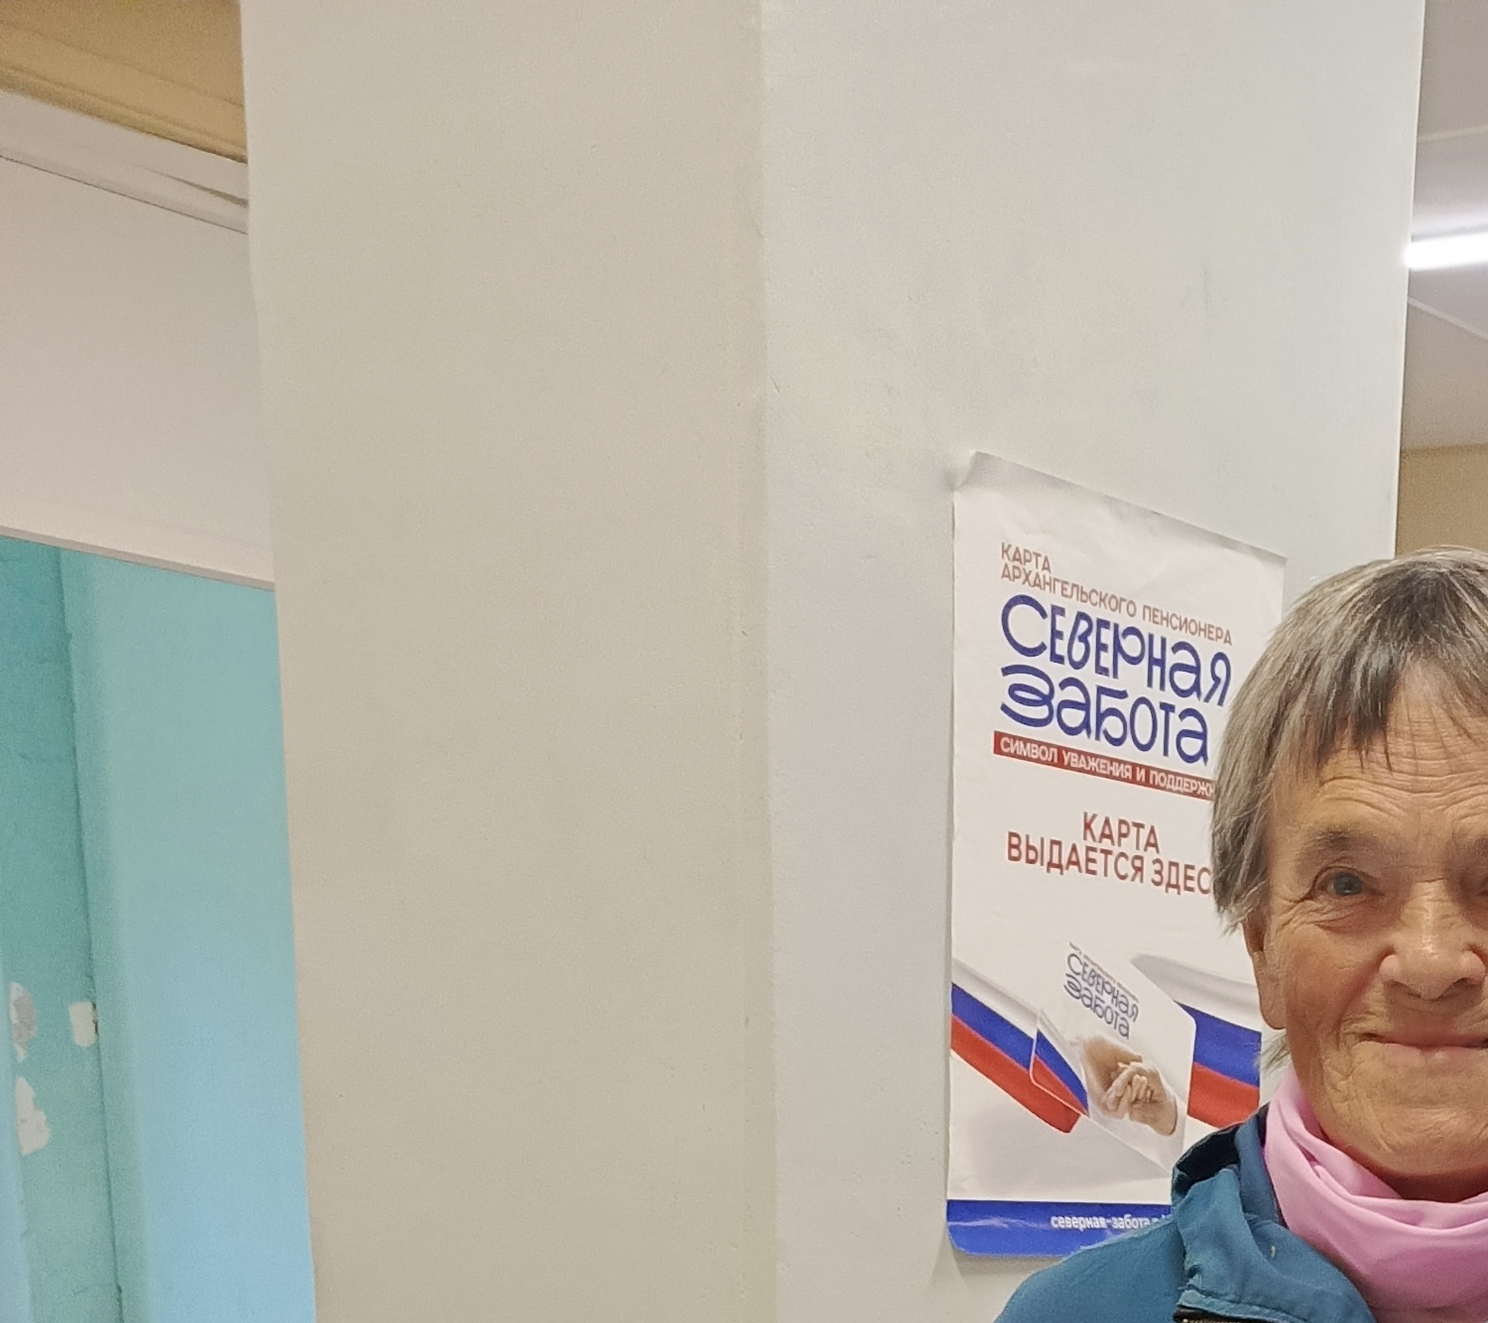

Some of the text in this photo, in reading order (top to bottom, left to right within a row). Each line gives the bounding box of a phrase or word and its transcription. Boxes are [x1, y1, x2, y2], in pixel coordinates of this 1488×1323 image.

[1001, 542, 1051, 573] КАРТА
[1001, 564, 1232, 646] АРХАНГЕЛЬСКОГО ПЕНСИОНЕРА
[1001, 594, 1232, 706] СЕВЕРНАЯ
[1000, 664, 1209, 766] ЗАБОТА
[1000, 737, 1058, 763] СИМВОЛ
[1063, 750, 1132, 780] УВАЖЕНИЯ
[1137, 767, 1145, 781] И
[1007, 831, 1144, 883] ВЫДАЕТСЯ
[1083, 812, 1160, 854] КАРТА
